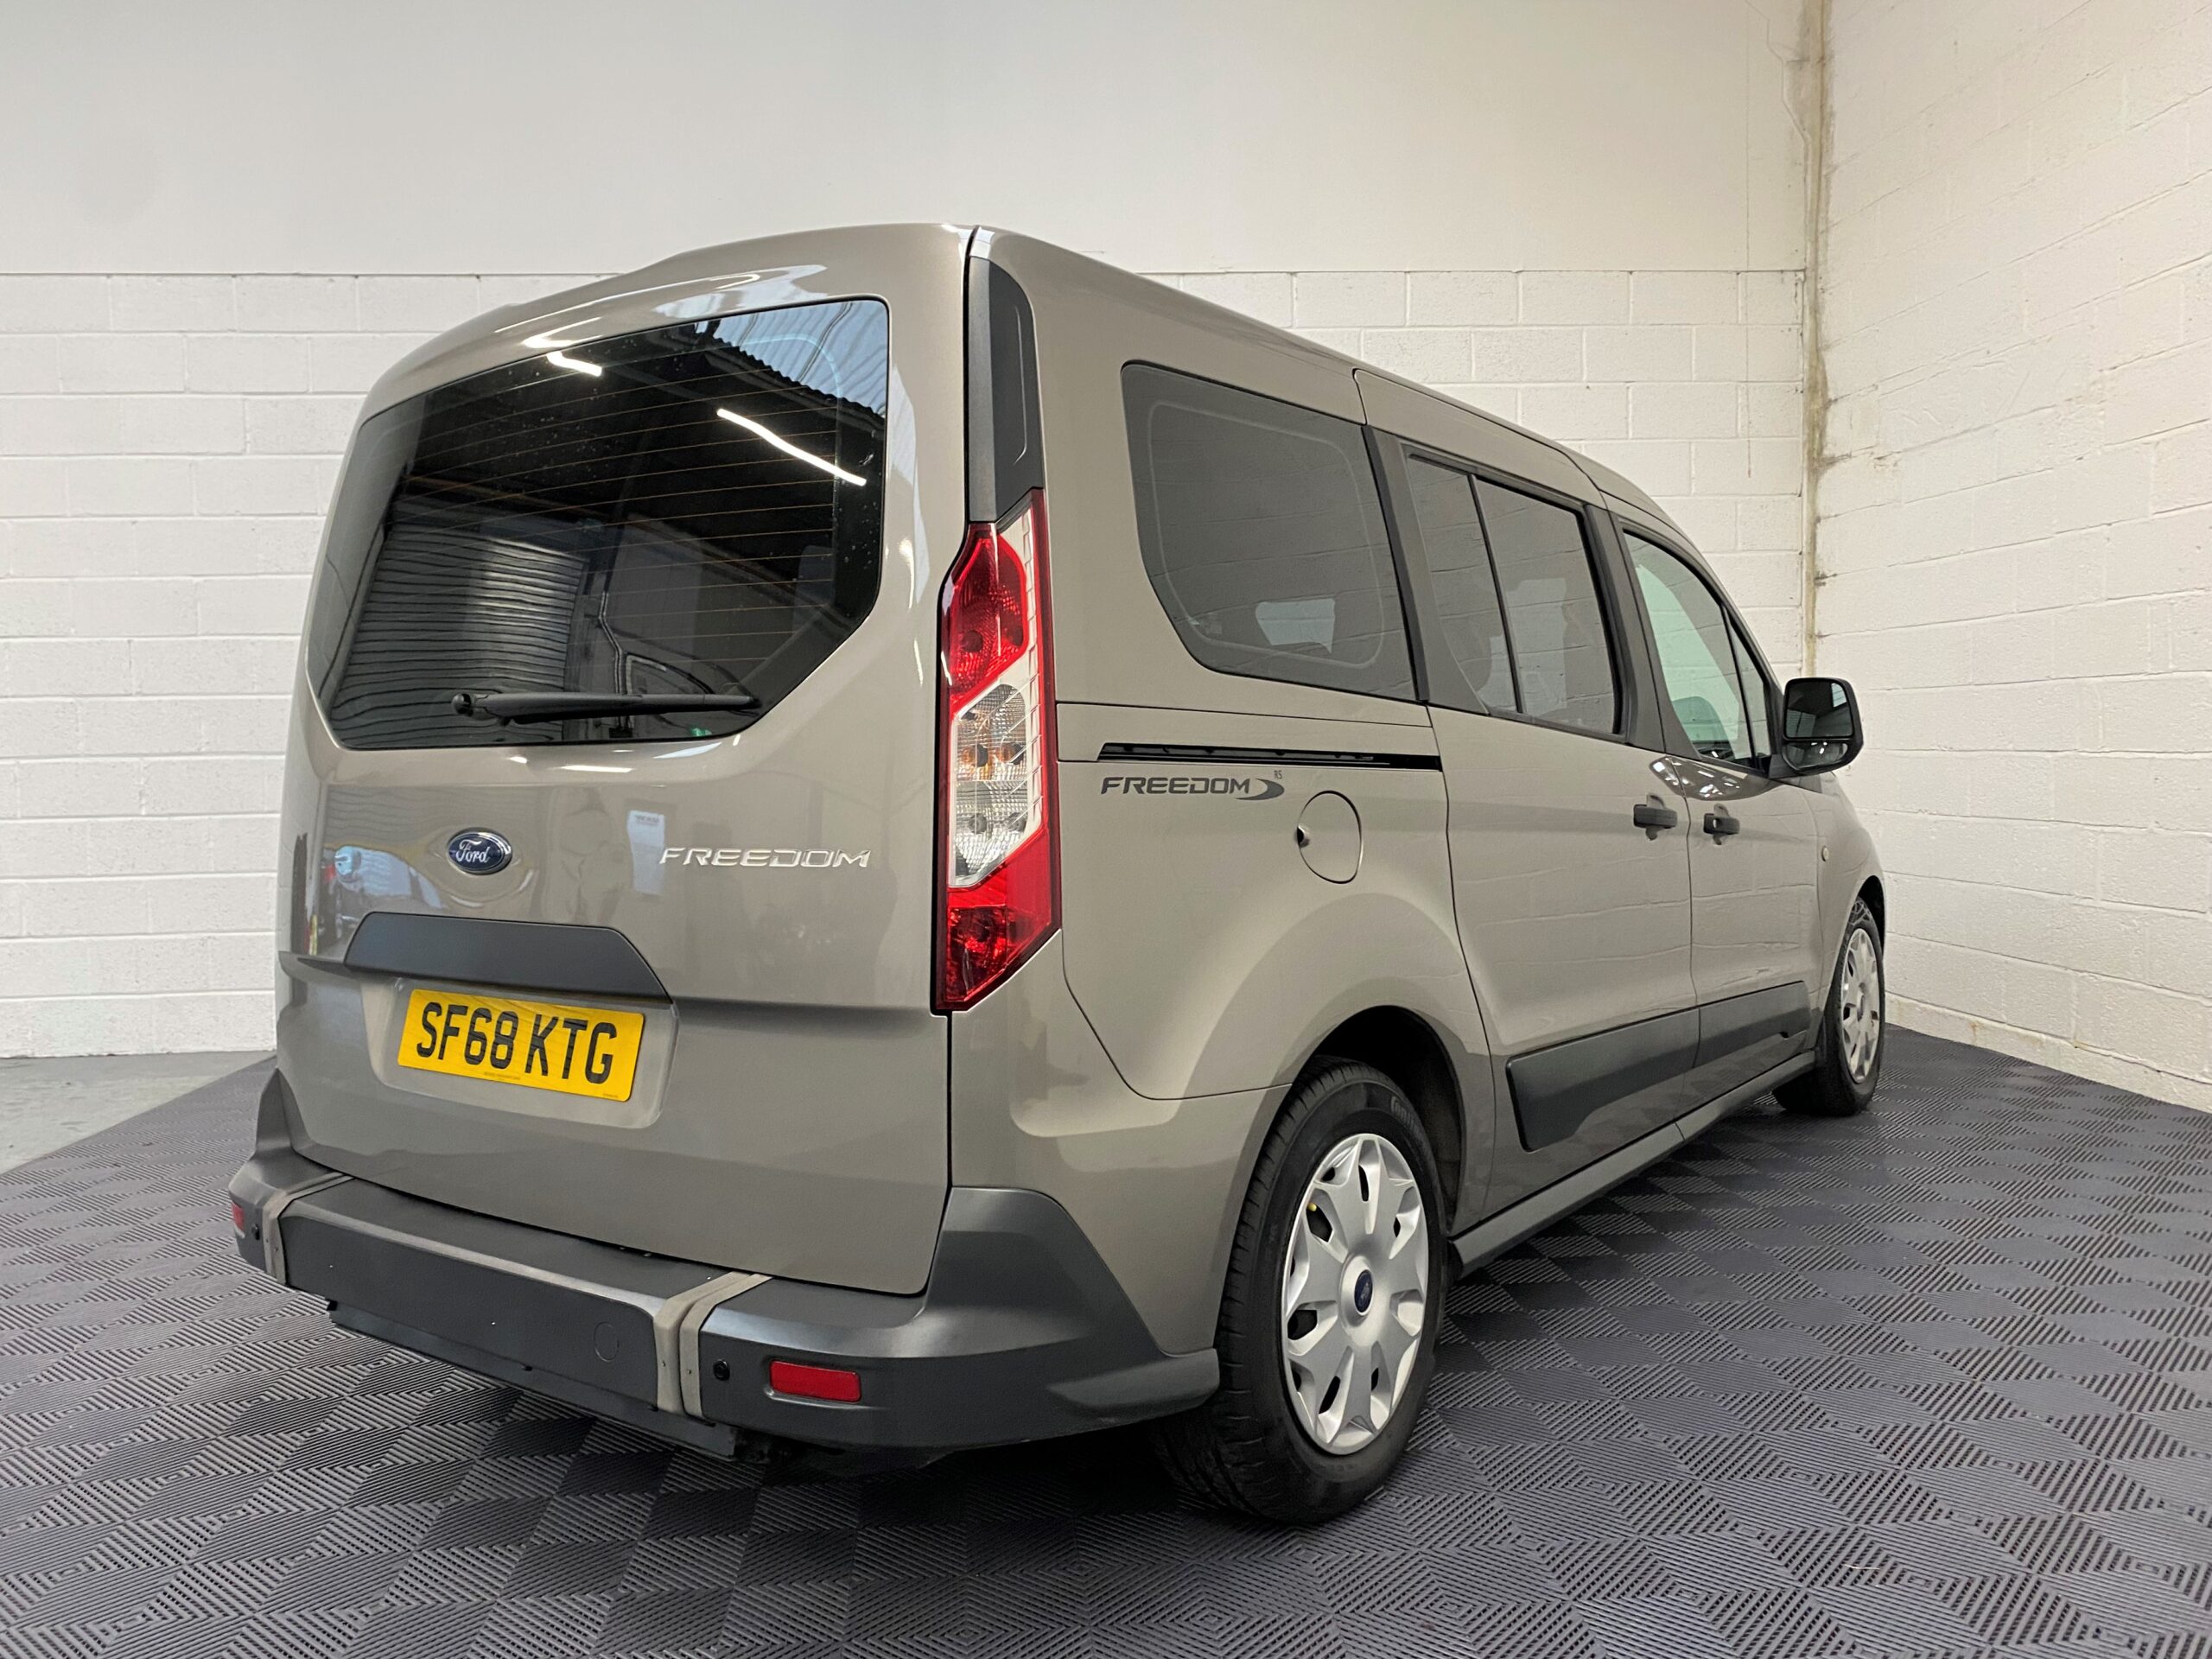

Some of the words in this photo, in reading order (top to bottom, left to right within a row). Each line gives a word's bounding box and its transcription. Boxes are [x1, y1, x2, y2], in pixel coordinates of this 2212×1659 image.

[1100, 776, 1250, 795] FREEDOM
[454, 838, 492, 864] Ford
[659, 847, 871, 868] FREEDOM
[416, 1001, 519, 1069] SF68
[524, 1014, 617, 1084] KTG
